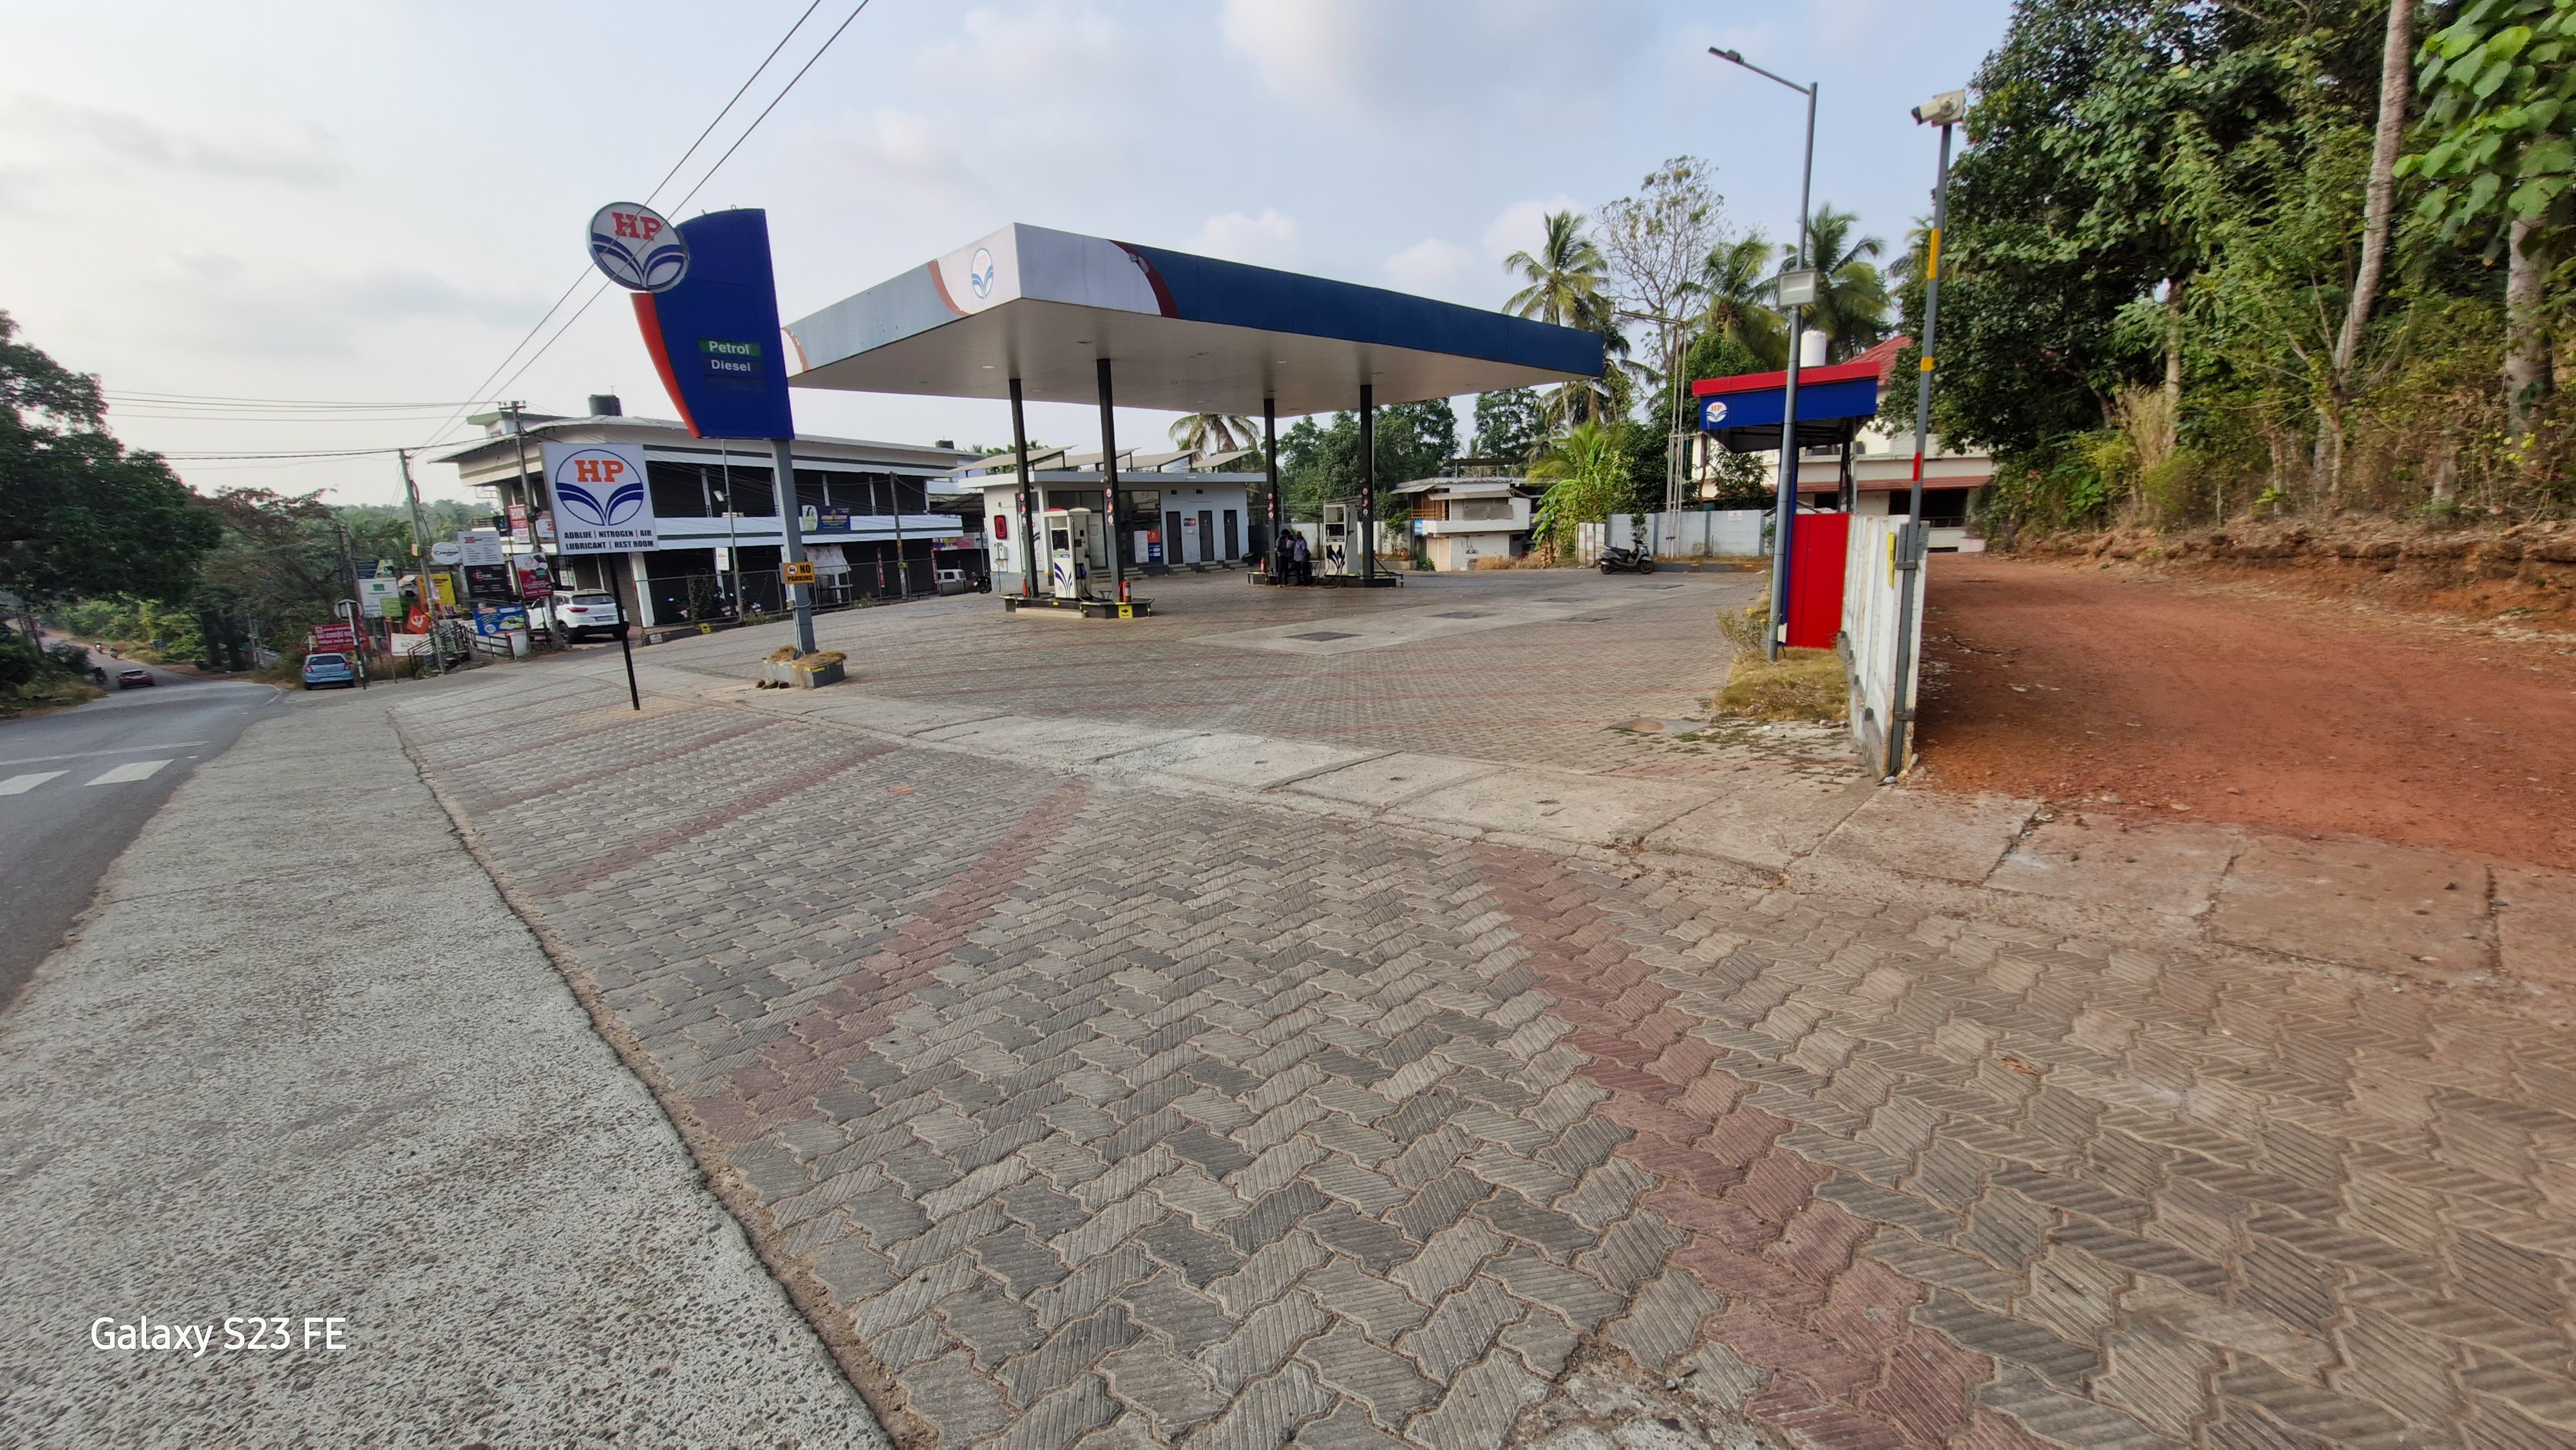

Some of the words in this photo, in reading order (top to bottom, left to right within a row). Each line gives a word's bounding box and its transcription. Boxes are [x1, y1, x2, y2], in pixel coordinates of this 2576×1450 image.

[612, 212, 661, 241] HP
[708, 341, 750, 355] Petrol
[710, 359, 751, 372] Diesel
[574, 460, 624, 482] HP
[564, 531, 592, 539] ADBLUE
[565, 541, 607, 550] LUBRICANT
[799, 564, 811, 574] NO
